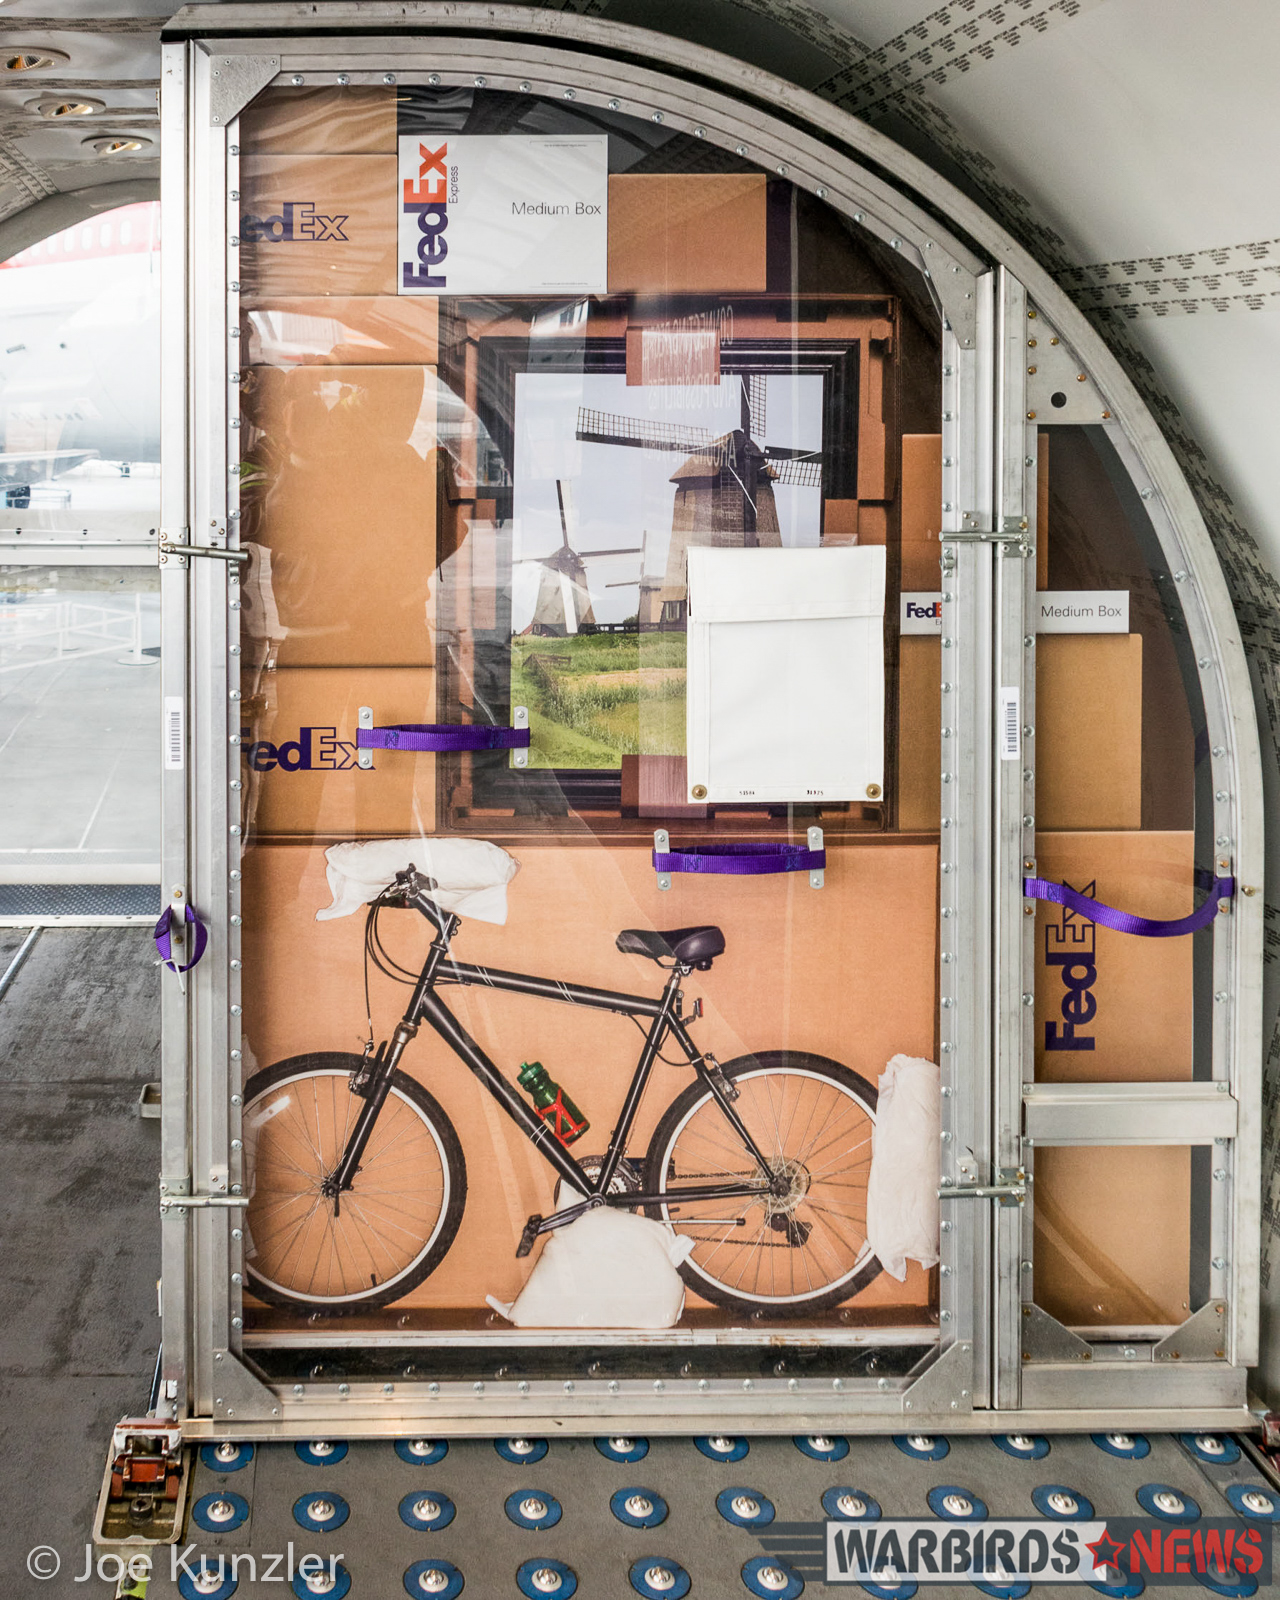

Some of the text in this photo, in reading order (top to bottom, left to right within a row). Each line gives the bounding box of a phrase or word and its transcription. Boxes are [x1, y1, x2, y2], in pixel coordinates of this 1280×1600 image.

[448, 165, 459, 204] Express
[403, 142, 448, 287] FedEx
[511, 201, 602, 216] Medium Box
[1041, 605, 1122, 617] Medium Box
